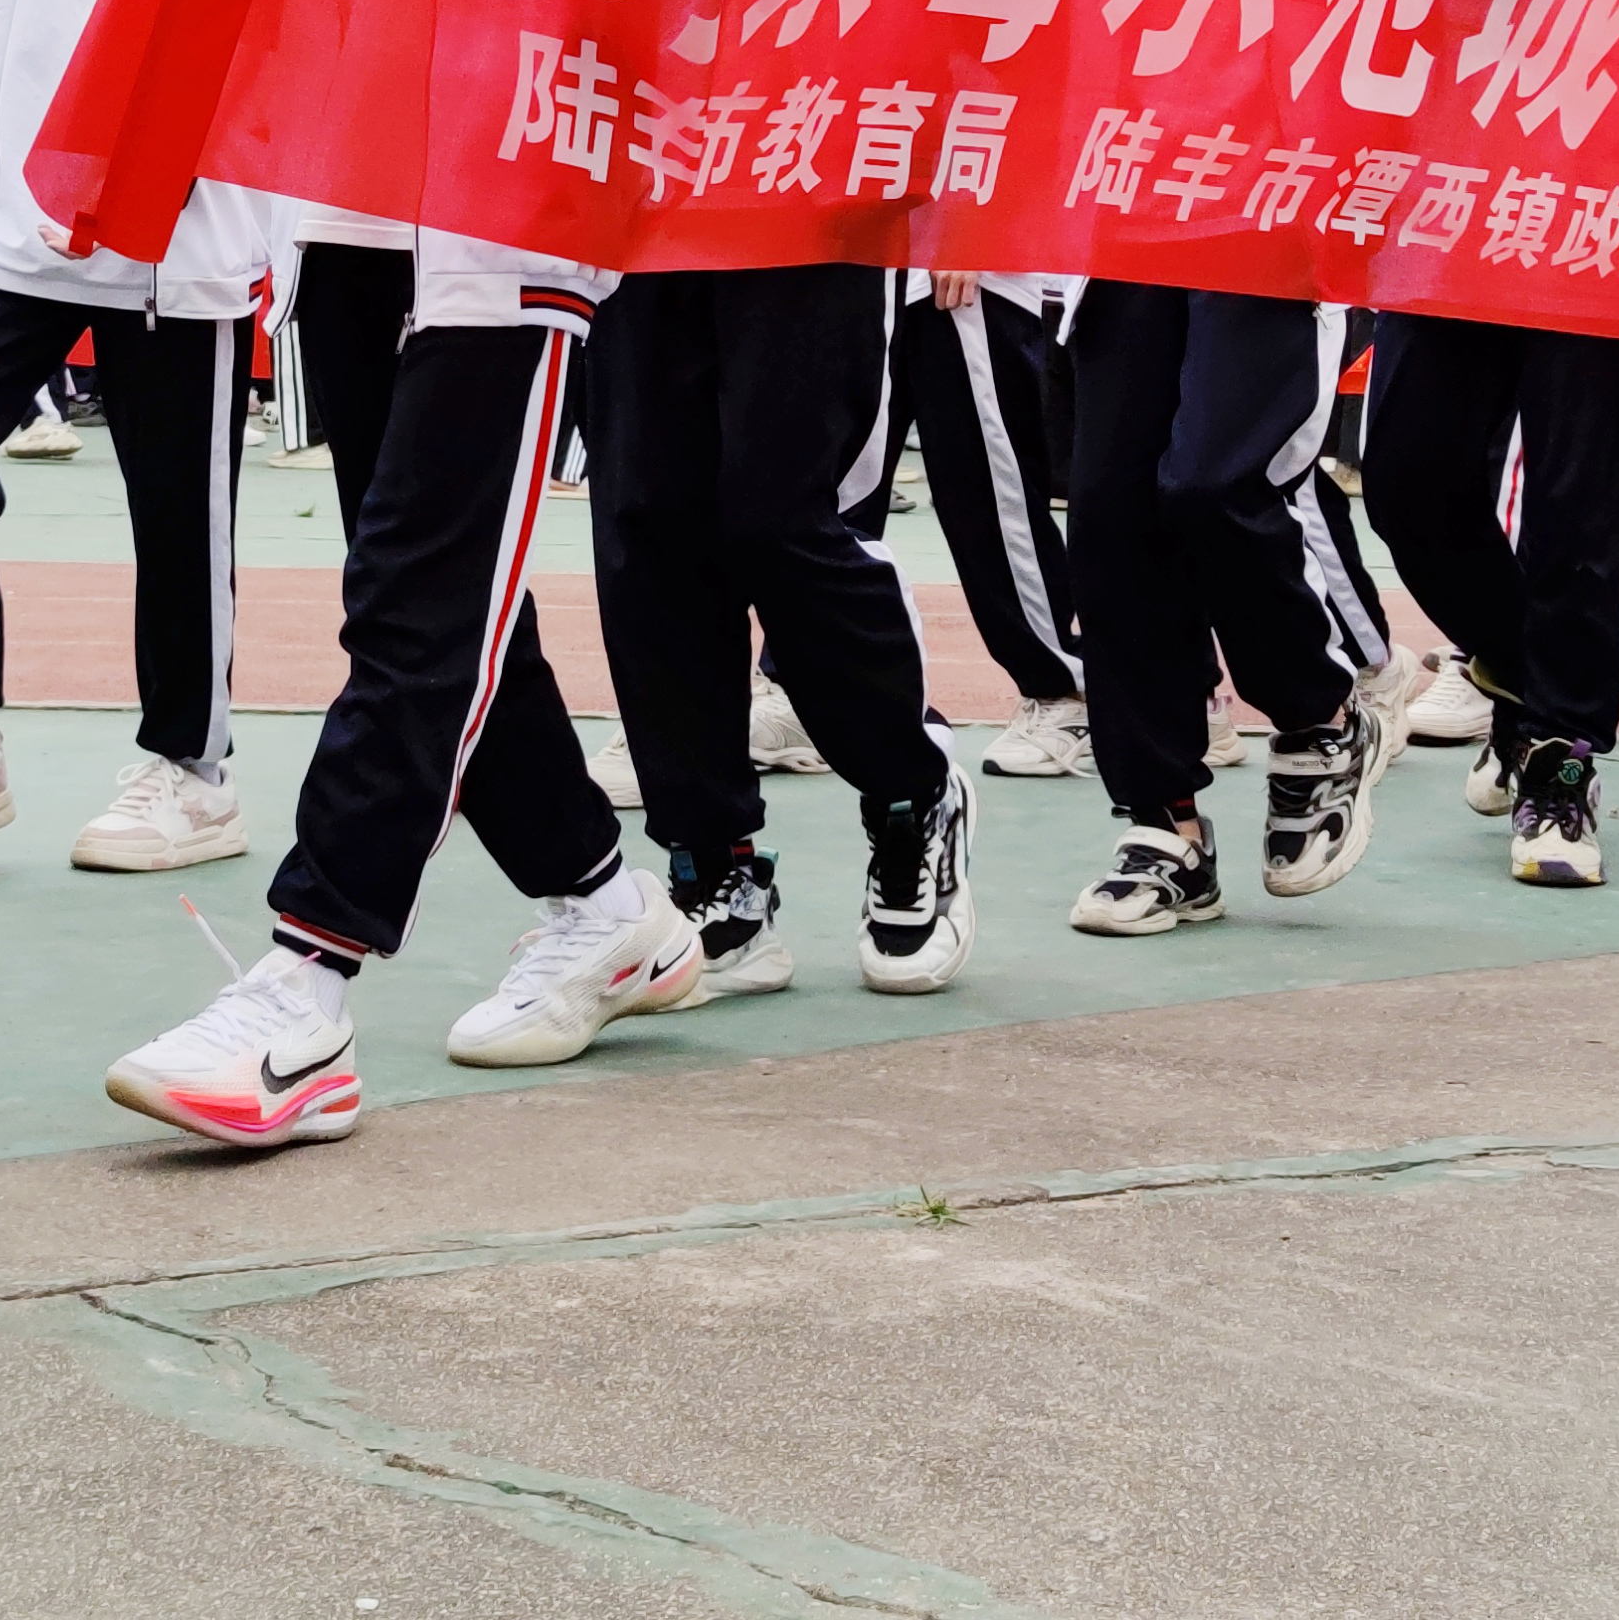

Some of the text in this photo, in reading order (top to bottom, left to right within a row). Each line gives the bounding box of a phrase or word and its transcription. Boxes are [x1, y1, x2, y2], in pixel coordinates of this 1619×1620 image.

[497, 29, 1019, 207] 陆丰市教育局
